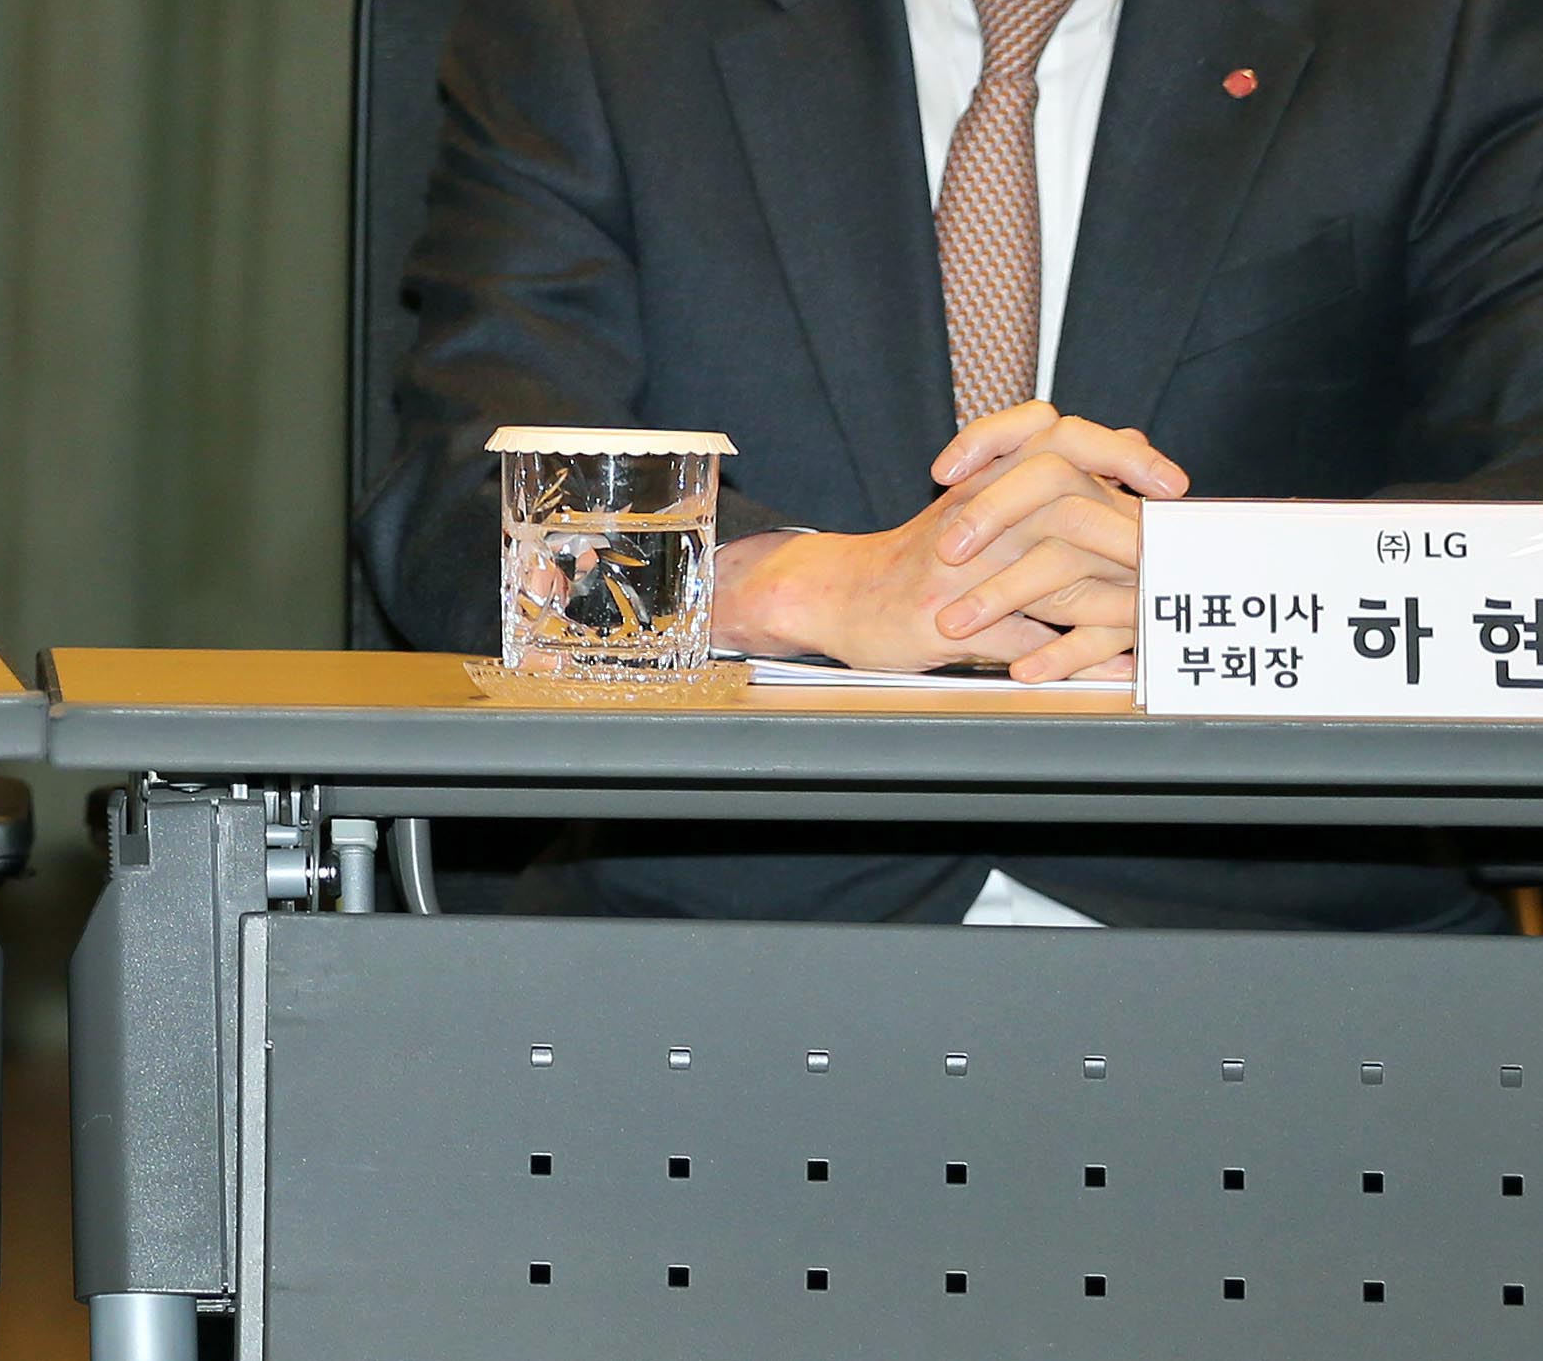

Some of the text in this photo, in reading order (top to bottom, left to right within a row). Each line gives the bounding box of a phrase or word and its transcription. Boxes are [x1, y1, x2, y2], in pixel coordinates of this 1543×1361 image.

[1424, 531, 1468, 559] LG
[1154, 593, 1325, 634] 대표이사
[1177, 646, 1305, 689] 부회장
